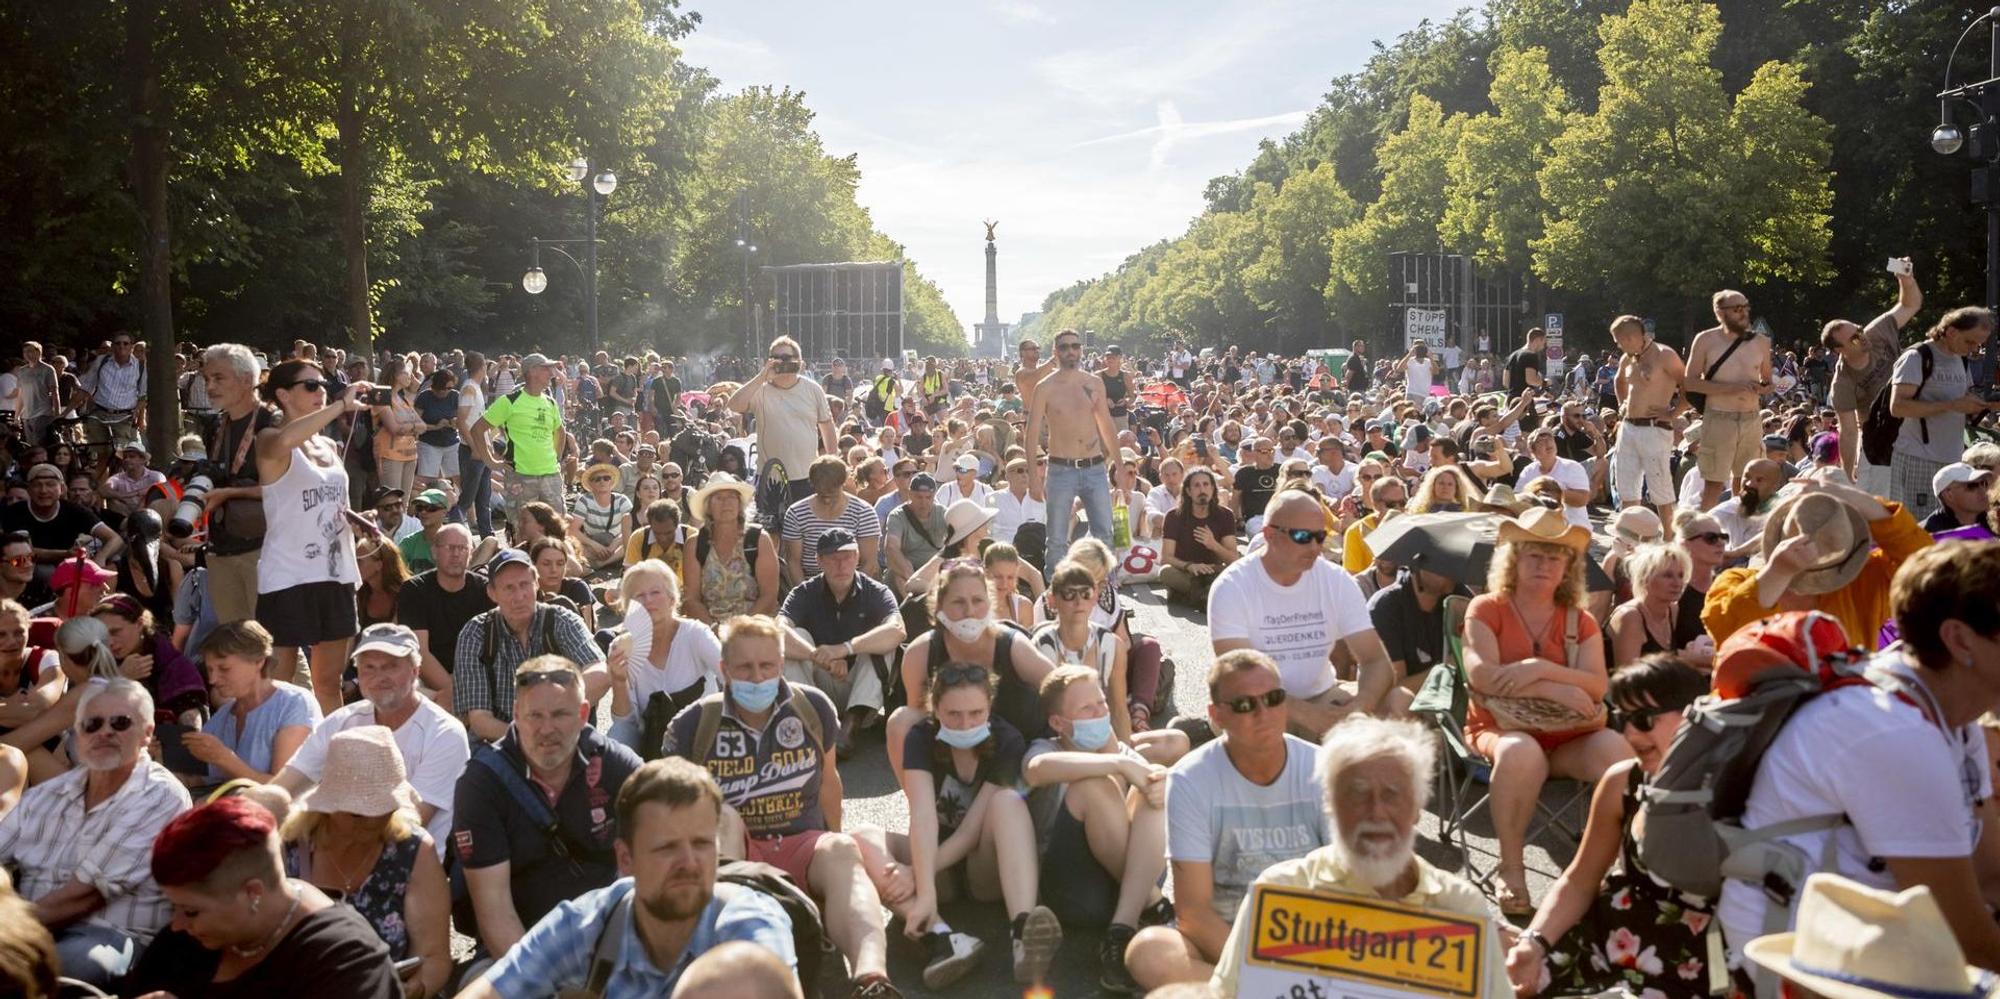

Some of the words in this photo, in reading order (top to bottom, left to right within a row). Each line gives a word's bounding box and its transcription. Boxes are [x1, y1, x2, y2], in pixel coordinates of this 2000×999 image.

[1410, 311, 1445, 322] STOPP
[1548, 316, 1558, 328] P
[1410, 324, 1445, 335] CHEM-
[1410, 336, 1444, 347] TILS
[1123, 545, 1157, 574] 8
[716, 731, 747, 757] 63
[707, 756, 754, 777] FIELD
[1234, 825, 1311, 850] VISIONS
[1269, 909, 1416, 962] Stuttgart
[1427, 935, 1467, 973] 21
